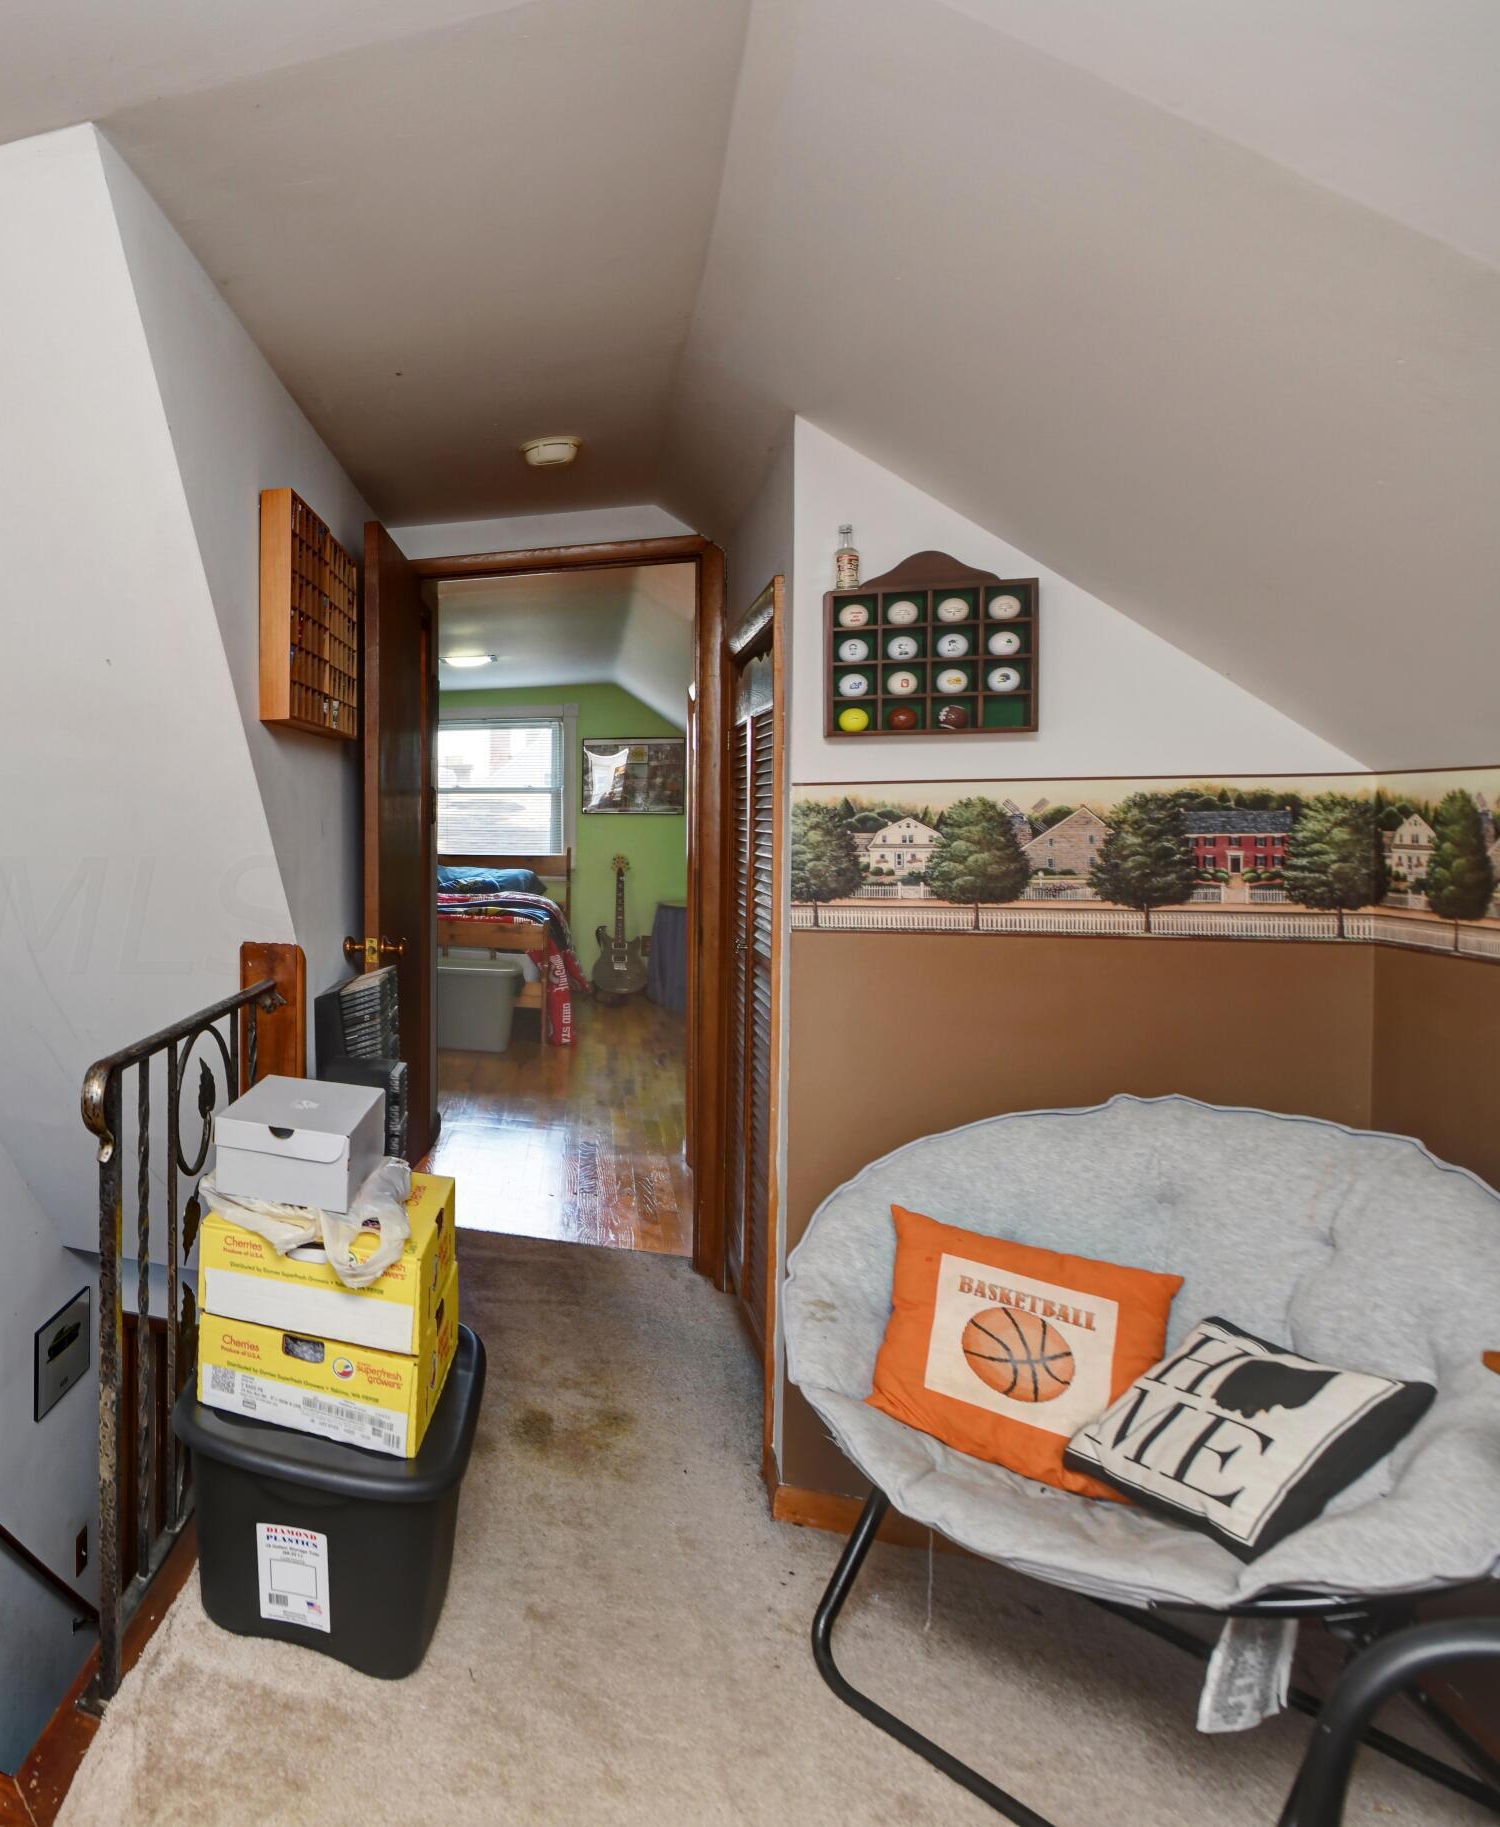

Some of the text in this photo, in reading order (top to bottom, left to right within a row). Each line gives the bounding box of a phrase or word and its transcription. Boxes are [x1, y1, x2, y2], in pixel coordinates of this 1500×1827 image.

[224, 1234, 263, 1252] Cherries
[958, 1274, 1097, 1331] BASKETBALL
[222, 1333, 260, 1352] Cherries
[266, 1526, 317, 1541] DIAMOND
[266, 1534, 318, 1549] PLASTICS
